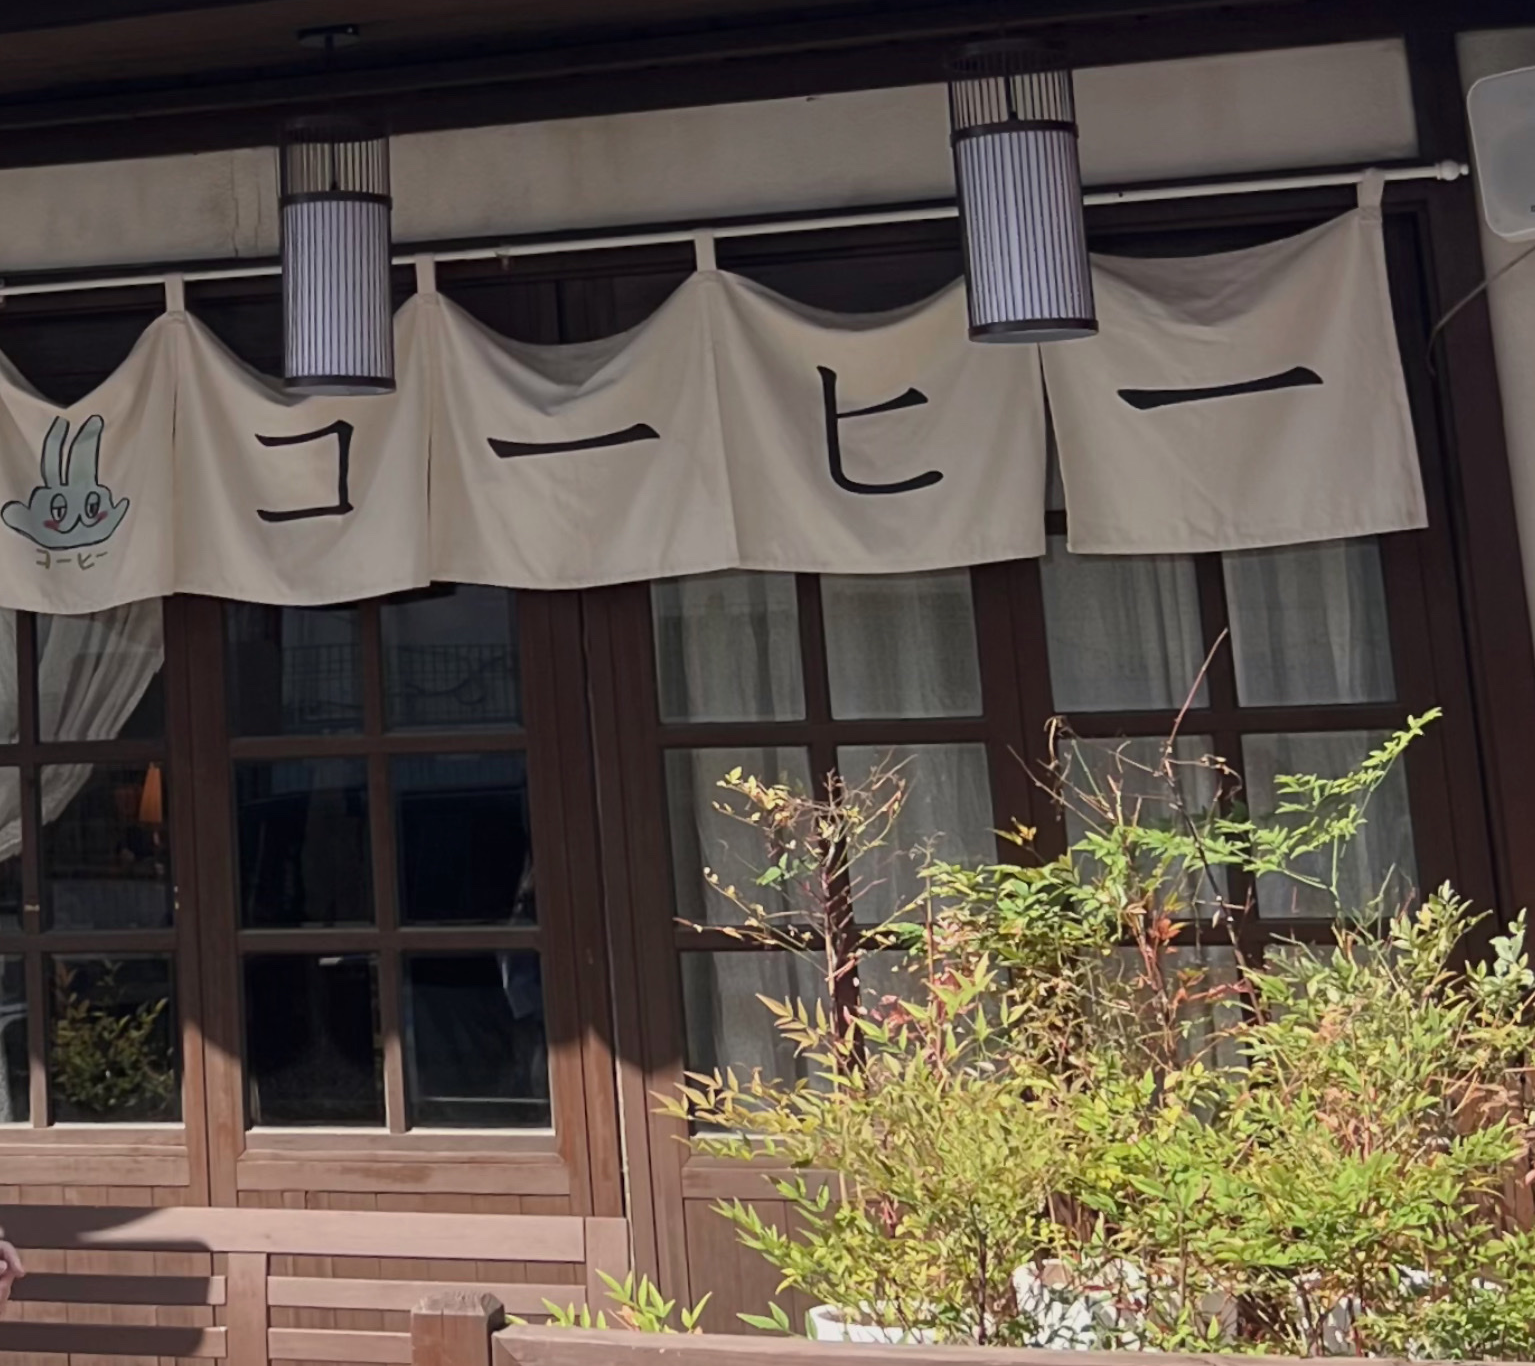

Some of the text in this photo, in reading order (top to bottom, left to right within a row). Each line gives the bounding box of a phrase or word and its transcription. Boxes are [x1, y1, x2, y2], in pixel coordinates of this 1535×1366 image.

[255, 364, 1325, 522] コーヒー
[36, 548, 108, 570] コーヒー
